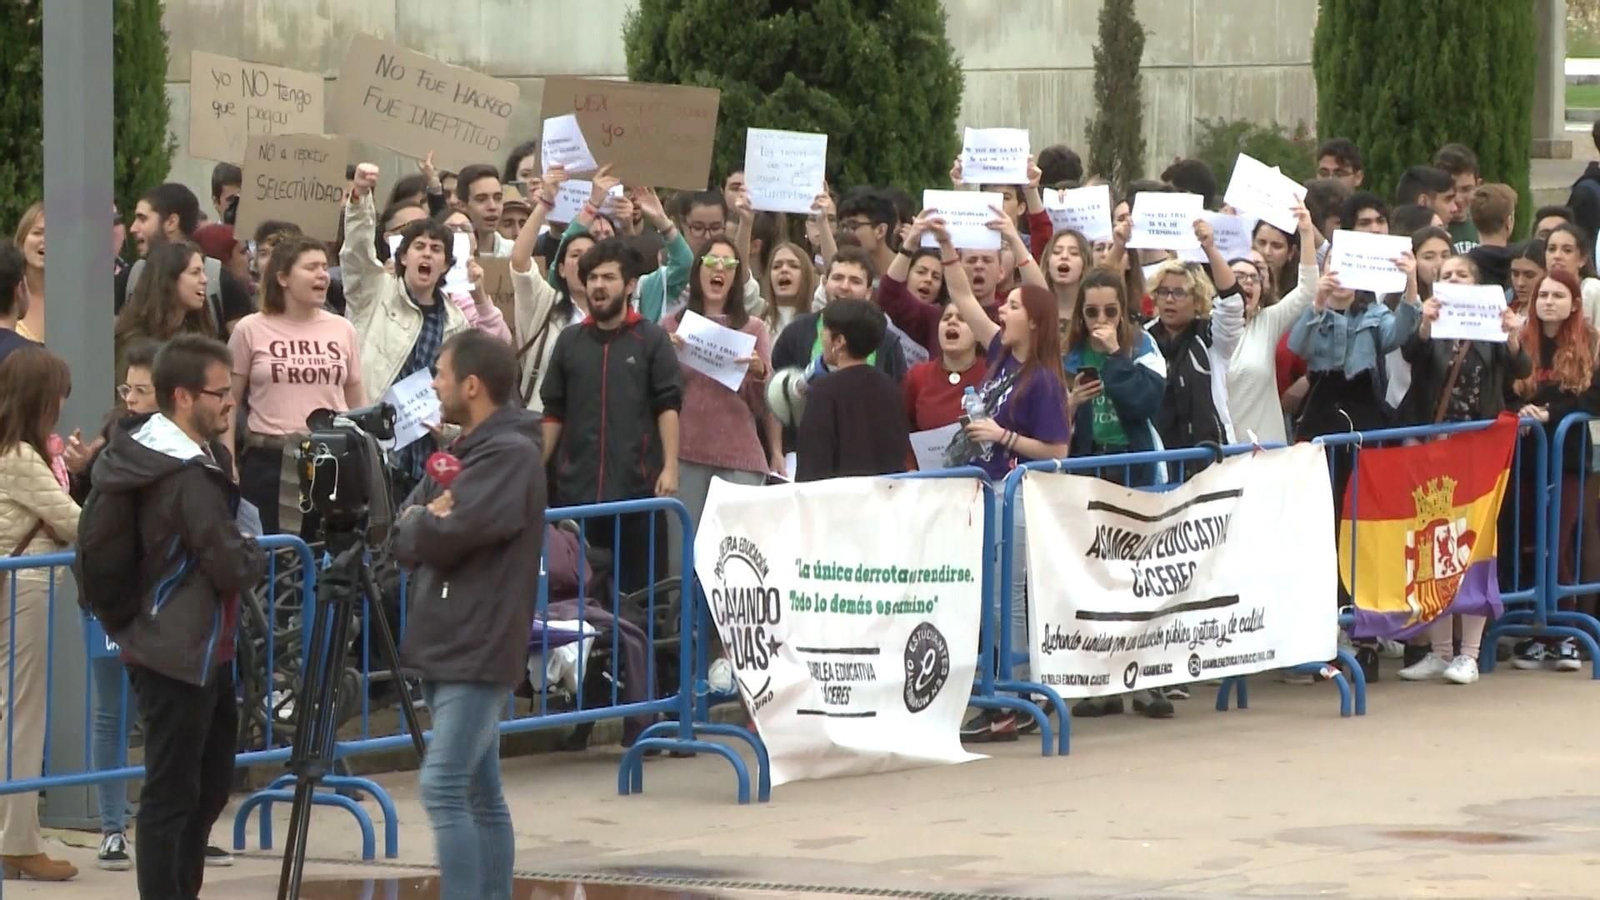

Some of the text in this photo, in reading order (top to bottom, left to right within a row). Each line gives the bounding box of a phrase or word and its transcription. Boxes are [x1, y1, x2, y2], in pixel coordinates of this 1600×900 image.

[241, 68, 269, 98] NO
[273, 77, 312, 112] tengo
[375, 53, 513, 119] NO FUE HACKEO
[363, 85, 403, 119] FUE
[211, 100, 292, 134] que pagar
[259, 142, 276, 161] NO
[269, 340, 341, 361] GIRLS
[292, 357, 328, 366] TO THE
[271, 363, 345, 387] FRONT
[813, 559, 853, 582] única
[854, 563, 909, 584] derrota
[917, 565, 975, 584] rendirse.
[814, 592, 827, 614] lo
[830, 593, 873, 615] demás
[835, 662, 877, 682] EDUCATIVA
